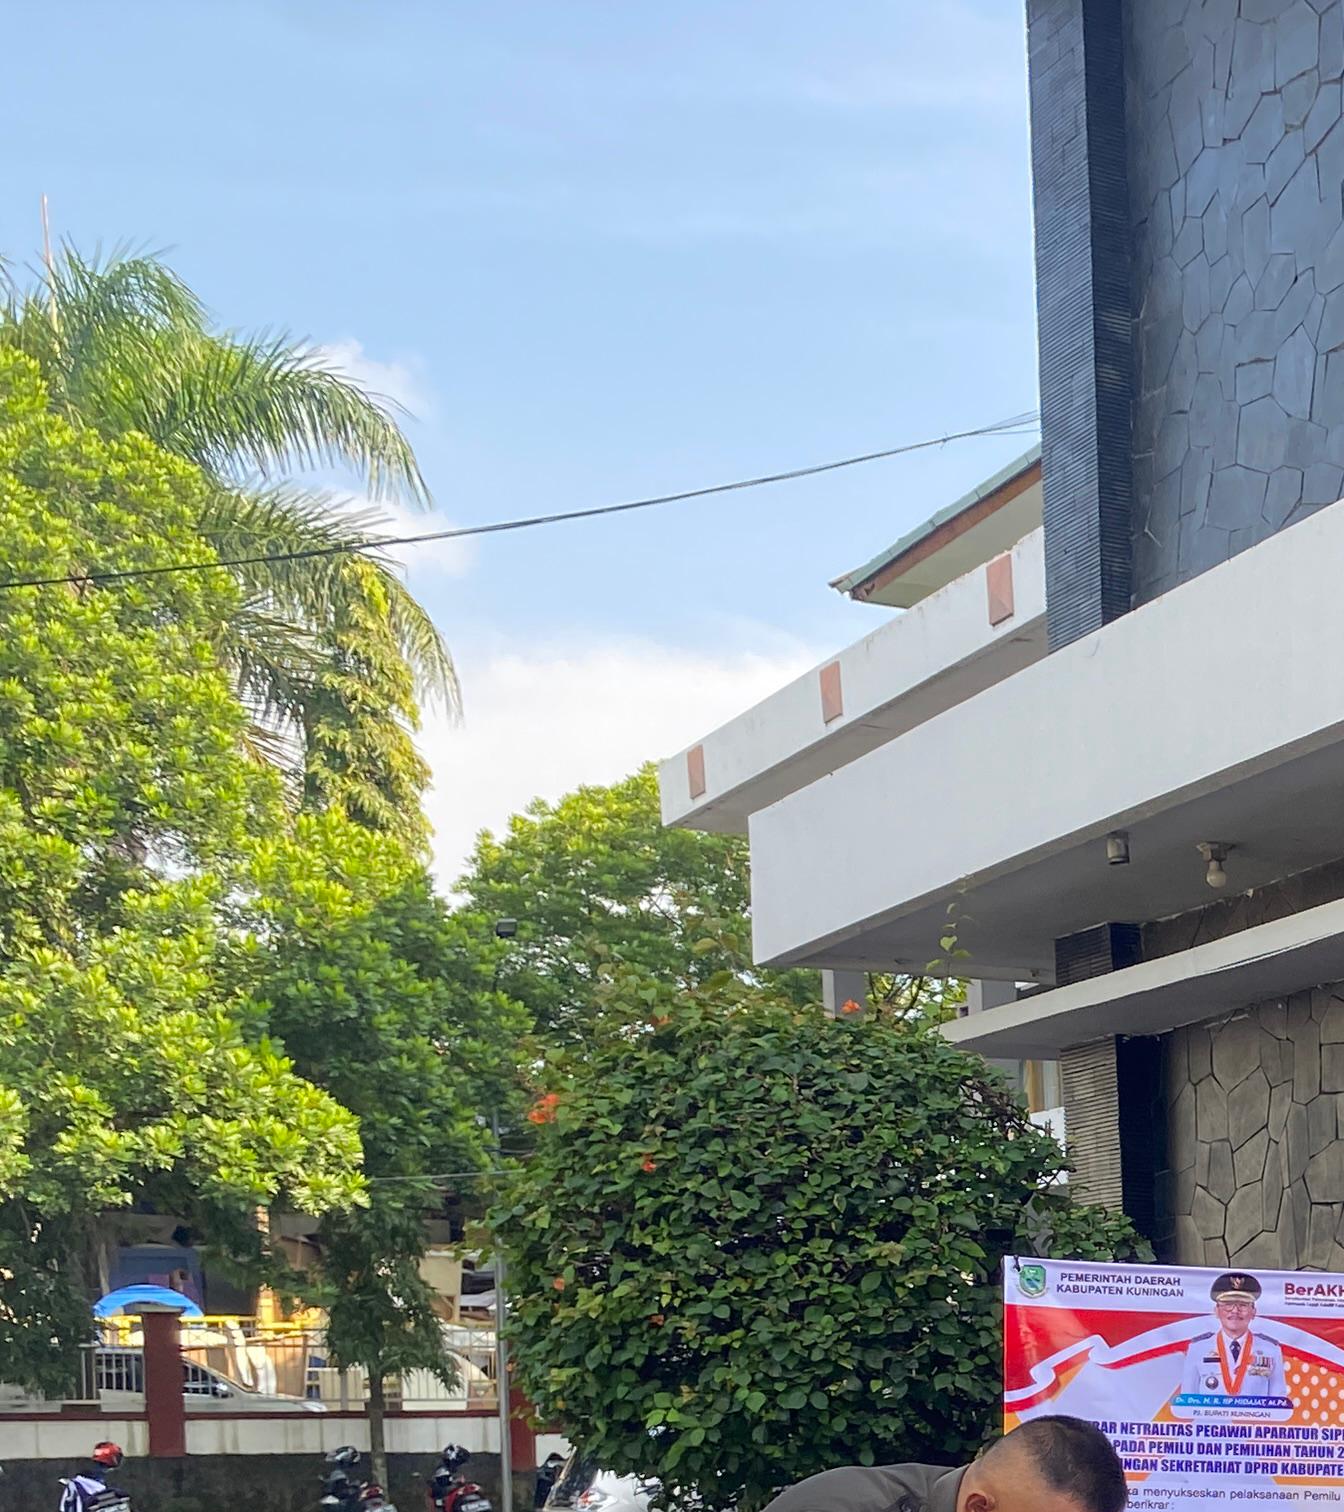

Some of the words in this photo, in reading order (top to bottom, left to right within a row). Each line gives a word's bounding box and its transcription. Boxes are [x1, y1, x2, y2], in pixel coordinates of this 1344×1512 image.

[1060, 1272, 1131, 1285] PEMERINTAH
[1134, 1275, 1181, 1286] DAERAH
[1056, 1284, 1122, 1295] KABUPATEN
[1126, 1286, 1184, 1297] KUNINGAN
[1230, 1410, 1271, 1418] KUNINGAN
[1120, 1422, 1193, 1437] NETRALITAS
[1196, 1424, 1252, 1439] PEGAWAI
[1255, 1426, 1318, 1441] APARATUR
[1113, 1439, 1146, 1453] PADA
[1149, 1440, 1194, 1455] PEMILU
[1197, 1442, 1222, 1456] DAN
[1225, 1443, 1291, 1457] PEMILIHAN
[1294, 1445, 1335, 1459] TAHUN
[1161, 1460, 1242, 1474] SEKRETARIAT
[1244, 1461, 1278, 1475] DPRD
[1143, 1487, 1226, 1499] menyukseskan
[1230, 1489, 1299, 1500] pelaksanaan
[1304, 1491, 1341, 1501] Pemilu
